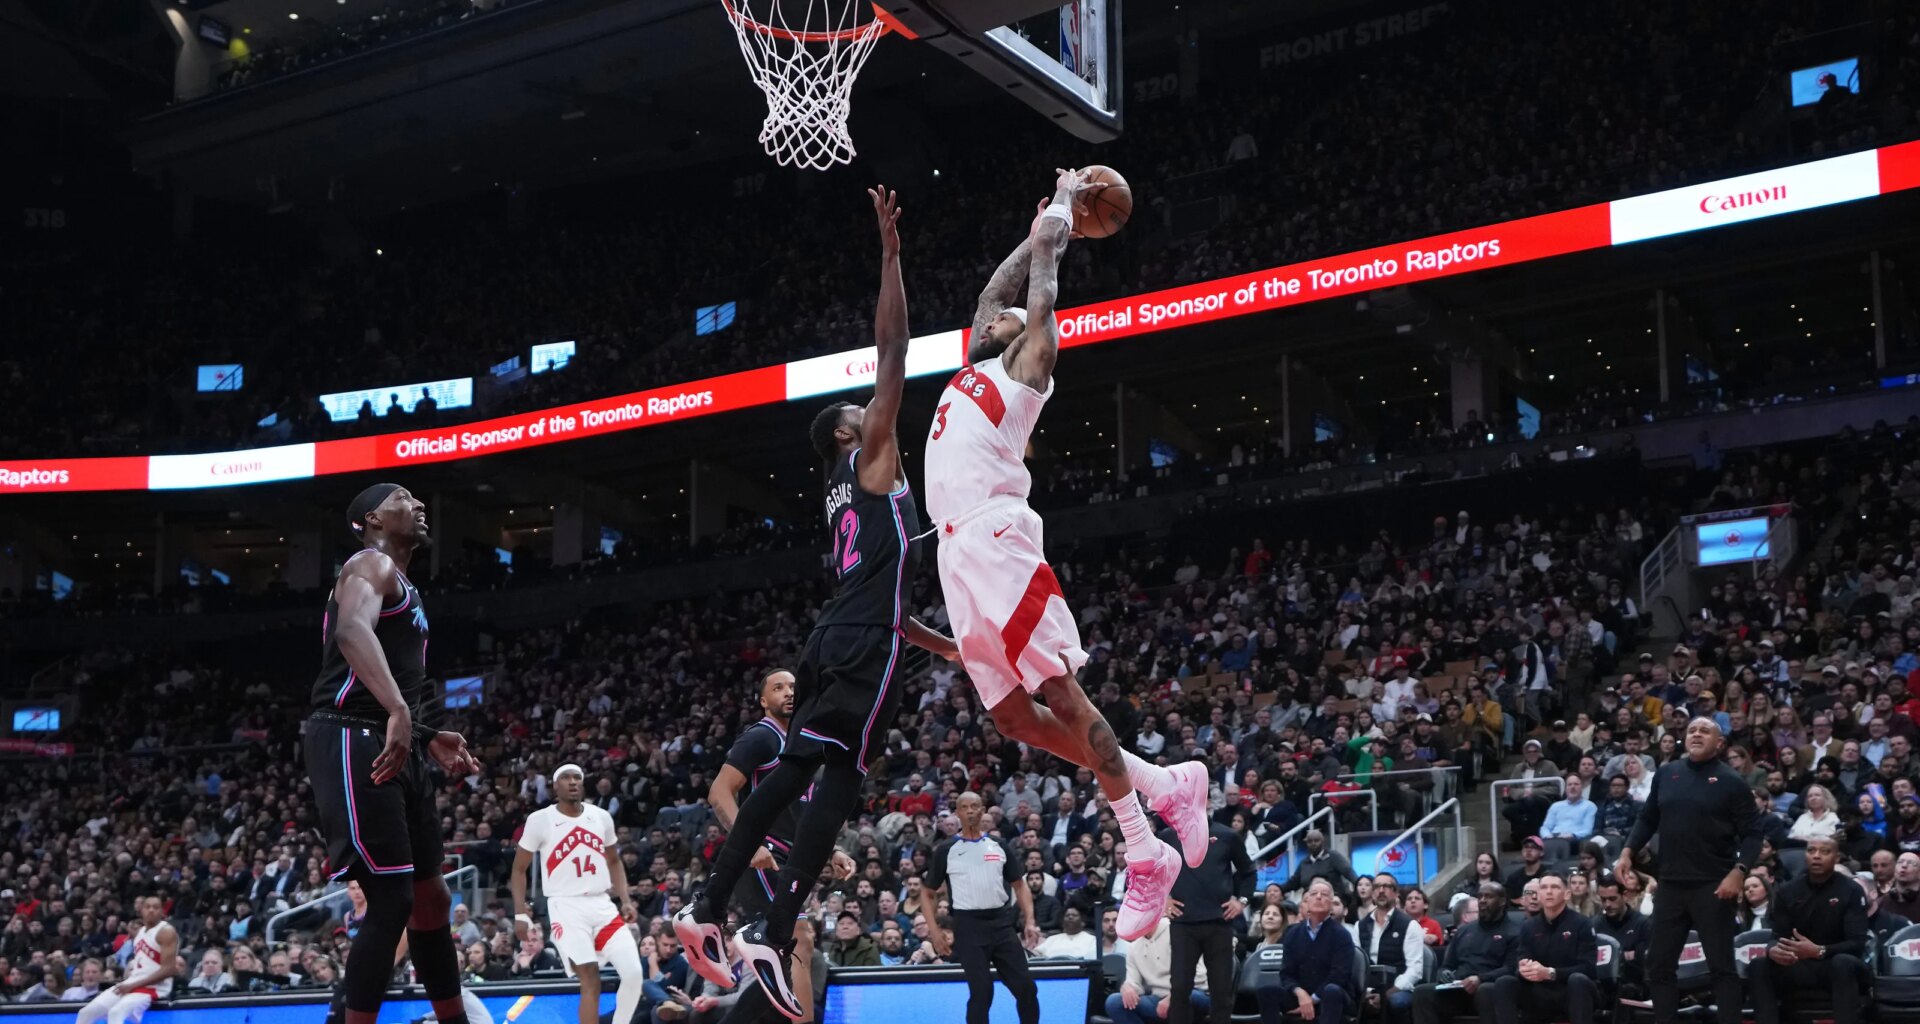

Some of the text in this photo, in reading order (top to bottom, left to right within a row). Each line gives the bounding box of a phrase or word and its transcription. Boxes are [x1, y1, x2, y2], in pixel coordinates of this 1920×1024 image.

[1260, 27, 1348, 69] FRONT
[1133, 72, 1178, 103] 320
[1699, 185, 1787, 213] Canon
[24, 207, 65, 228] 318
[1058, 239, 1500, 338] Official Sponsor of the Toronto Raptors
[396, 390, 713, 457] Official Sponsor of the Toronto Raptors
[932, 402, 951, 441] 3
[0, 468, 69, 488] Raptors
[210, 462, 262, 475] Canon
[833, 509, 861, 579] 2
[555, 831, 605, 860] RAPTORS
[571, 854, 596, 877] 14
